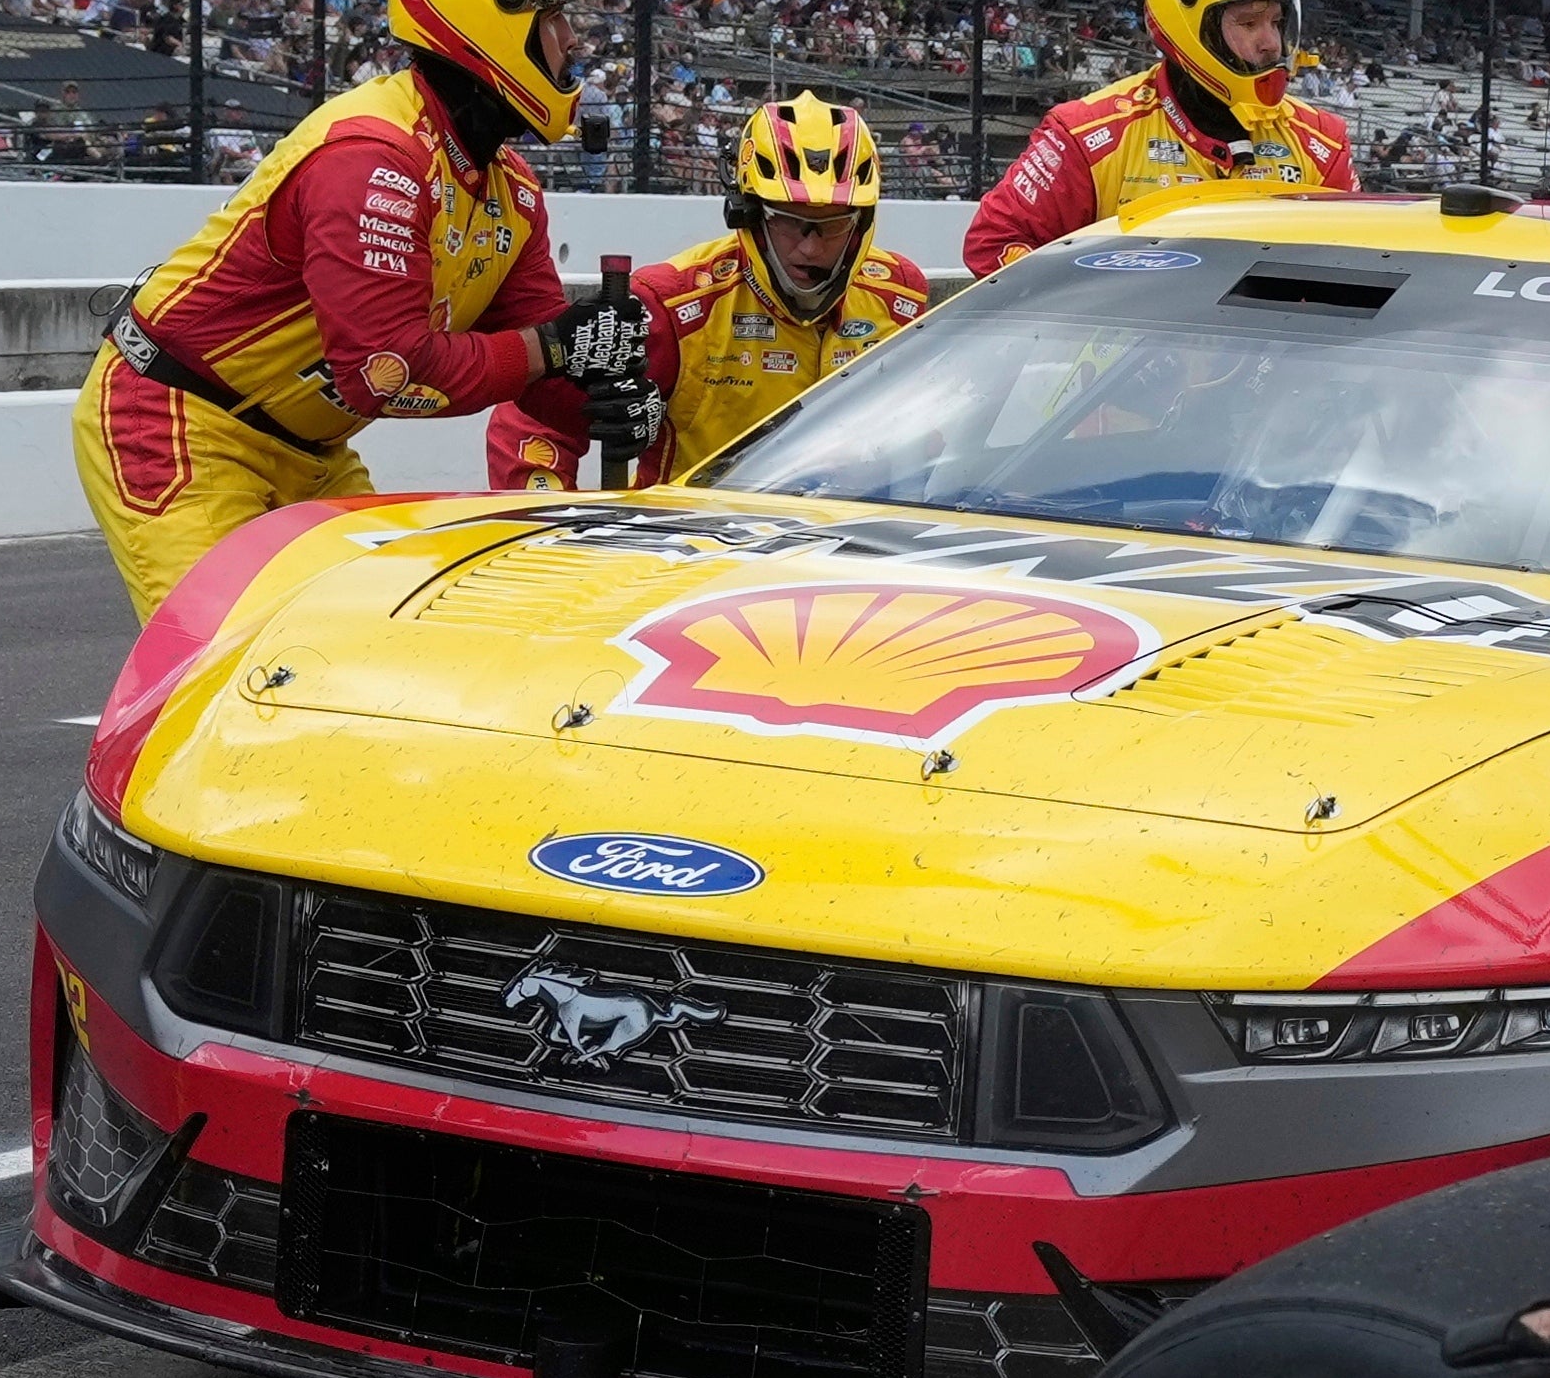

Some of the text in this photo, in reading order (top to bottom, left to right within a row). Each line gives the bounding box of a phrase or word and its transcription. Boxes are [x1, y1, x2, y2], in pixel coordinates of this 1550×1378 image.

[1086, 130, 1112, 148] OMP
[371, 167, 420, 195] FORD
[359, 213, 414, 239] Mazak
[358, 232, 415, 254] SIEMENS
[373, 252, 407, 272] PVA
[1095, 251, 1180, 270] Ford
[588, 310, 616, 369] Mechanix
[388, 395, 440, 411] ENNZOIL
[568, 839, 720, 888] Ford
